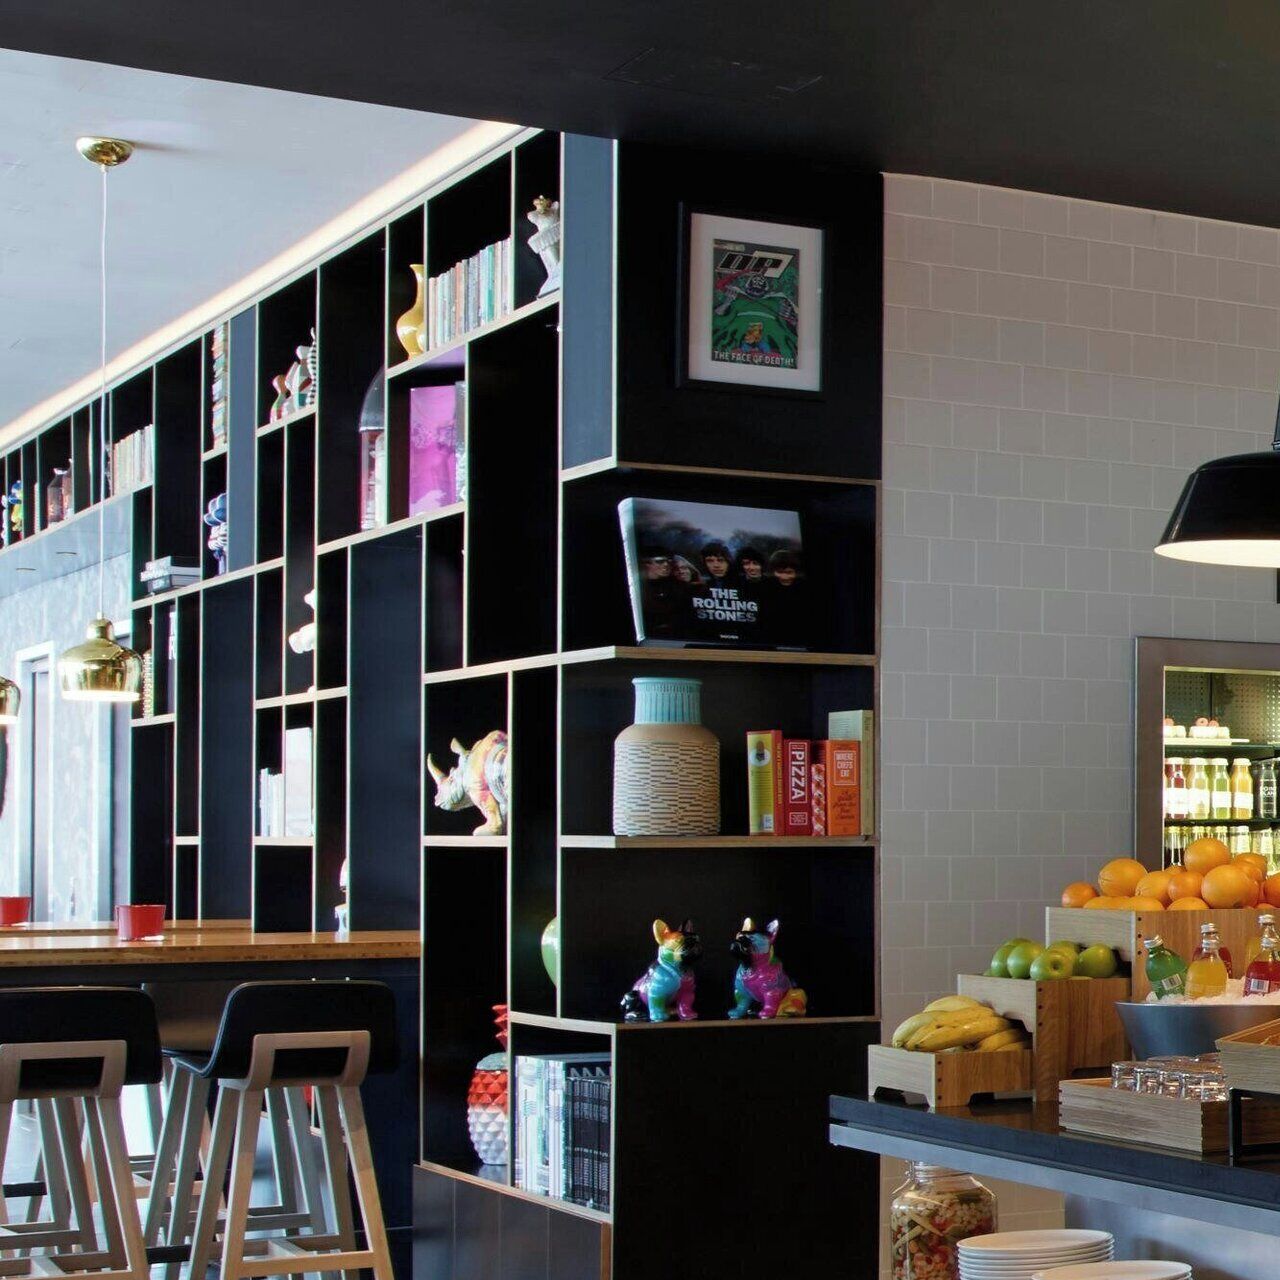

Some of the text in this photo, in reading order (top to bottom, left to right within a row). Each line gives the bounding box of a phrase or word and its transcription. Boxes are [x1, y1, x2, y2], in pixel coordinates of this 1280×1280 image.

[714, 350, 729, 360] THE
[731, 353, 751, 361] FACE
[753, 354, 763, 363] OF
[709, 588, 739, 600] THE
[692, 597, 758, 612] ROLLING
[697, 609, 757, 622] STONES
[791, 750, 806, 800] PIZZA
